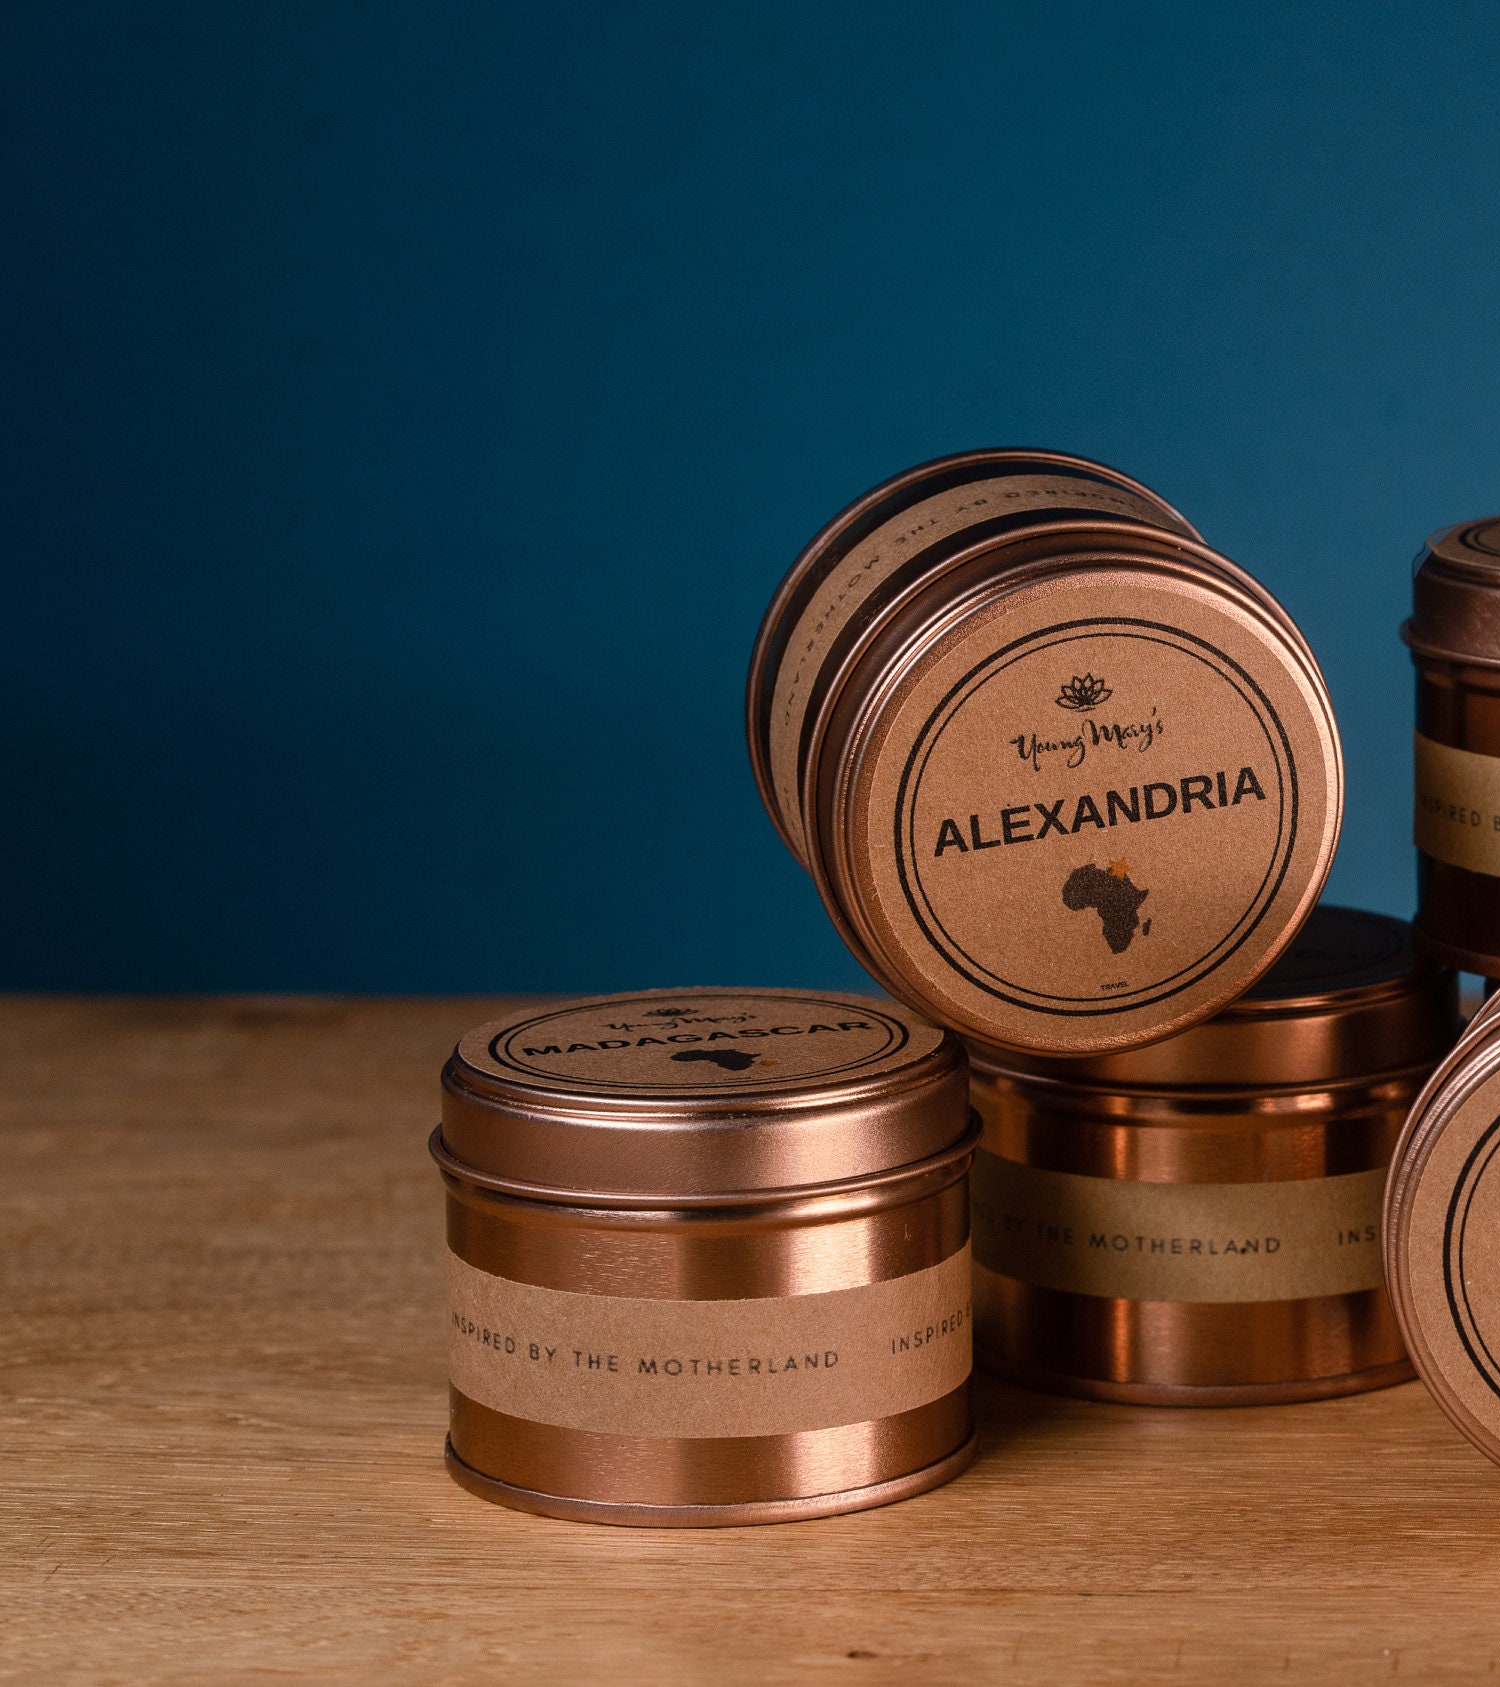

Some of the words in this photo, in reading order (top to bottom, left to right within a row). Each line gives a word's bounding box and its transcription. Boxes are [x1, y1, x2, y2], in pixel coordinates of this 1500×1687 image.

[894, 518, 939, 545] THE
[1009, 732, 1086, 772] Young
[1082, 706, 1164, 753] Mary's
[934, 766, 1267, 858] ALEXANDRIA
[1100, 981, 1129, 991] TRAVEL
[521, 1021, 873, 1057] MADAGASCAR
[1037, 1222, 1073, 1245] THE
[1089, 1232, 1281, 1255] MOTHERLAND
[891, 1311, 963, 1355] INSPIRED
[529, 1343, 557, 1362] BY
[573, 1351, 619, 1372] THE
[637, 1351, 839, 1377] MOTHERLAND
